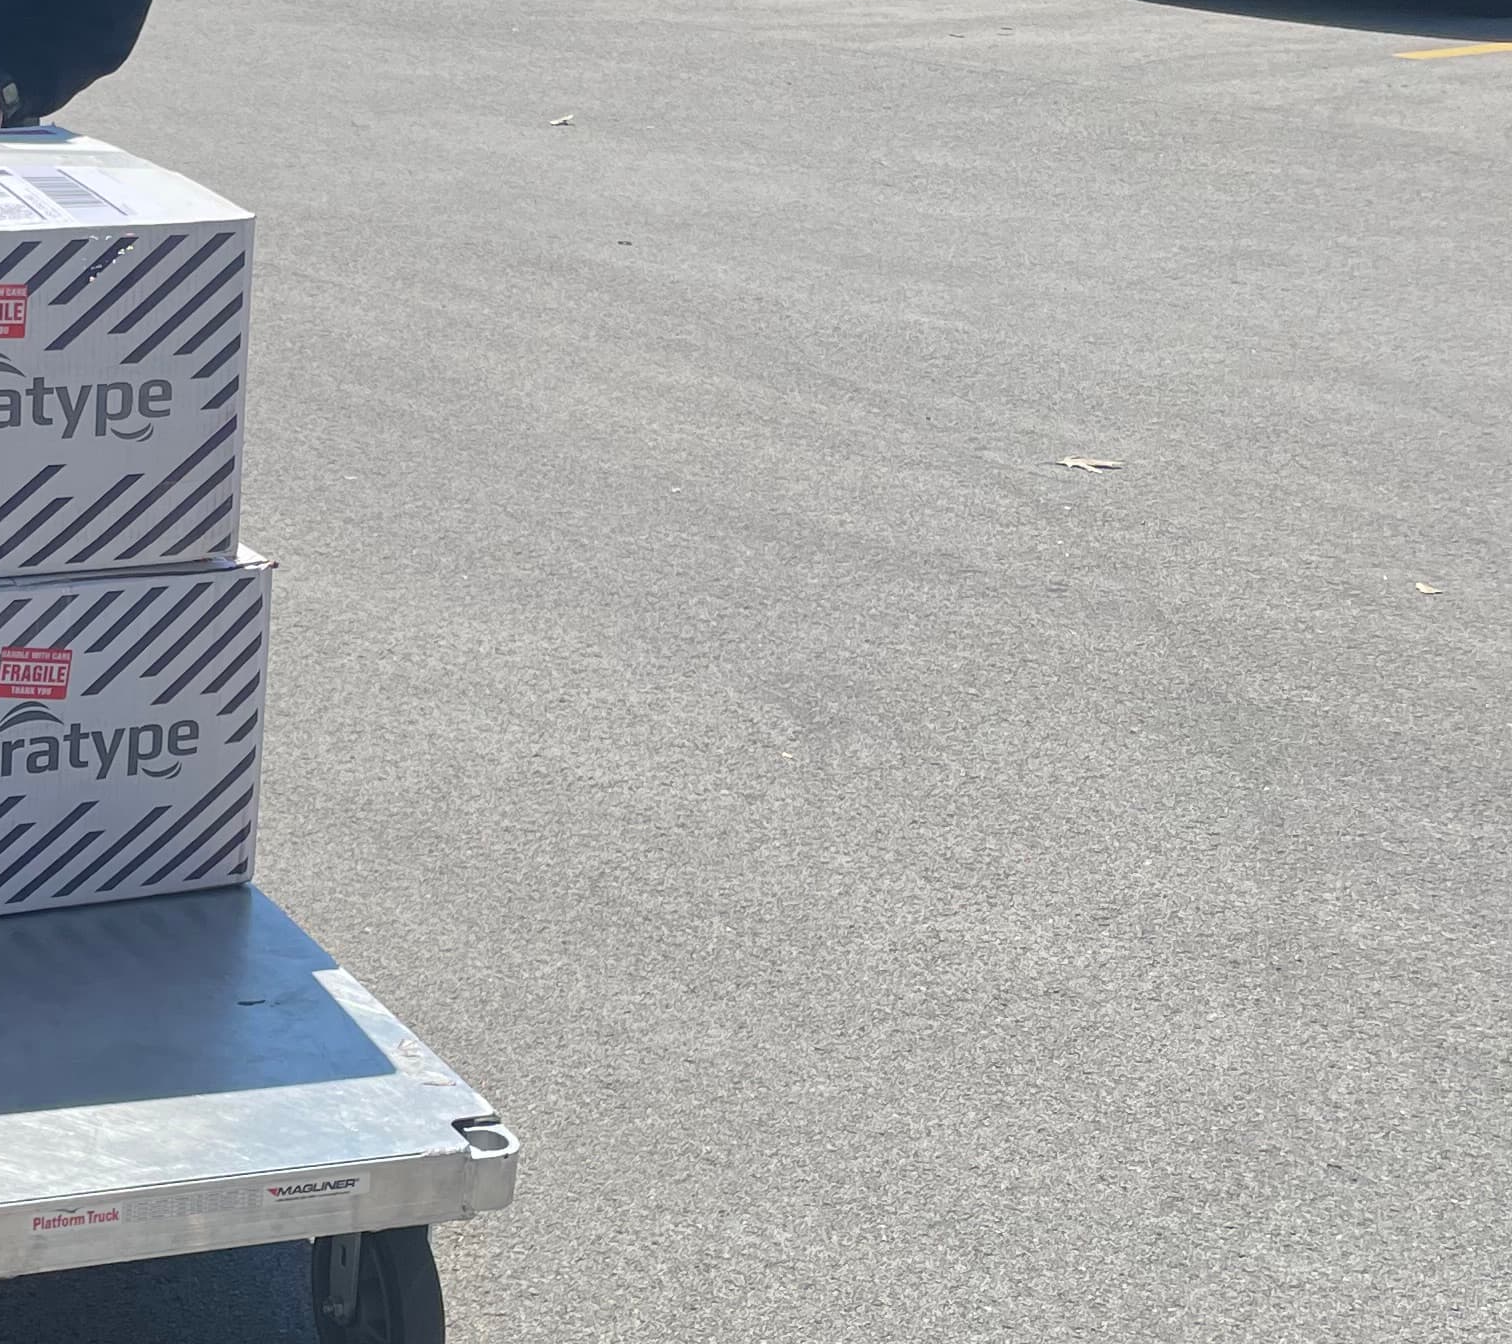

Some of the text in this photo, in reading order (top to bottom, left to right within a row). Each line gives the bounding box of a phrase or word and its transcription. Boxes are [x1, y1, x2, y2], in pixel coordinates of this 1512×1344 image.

[1, 663, 67, 683] FRAGILE
[11, 685, 53, 695] THANK YOU
[276, 1178, 356, 1197] MAGLINER
[32, 1207, 120, 1231] Platform Truck
